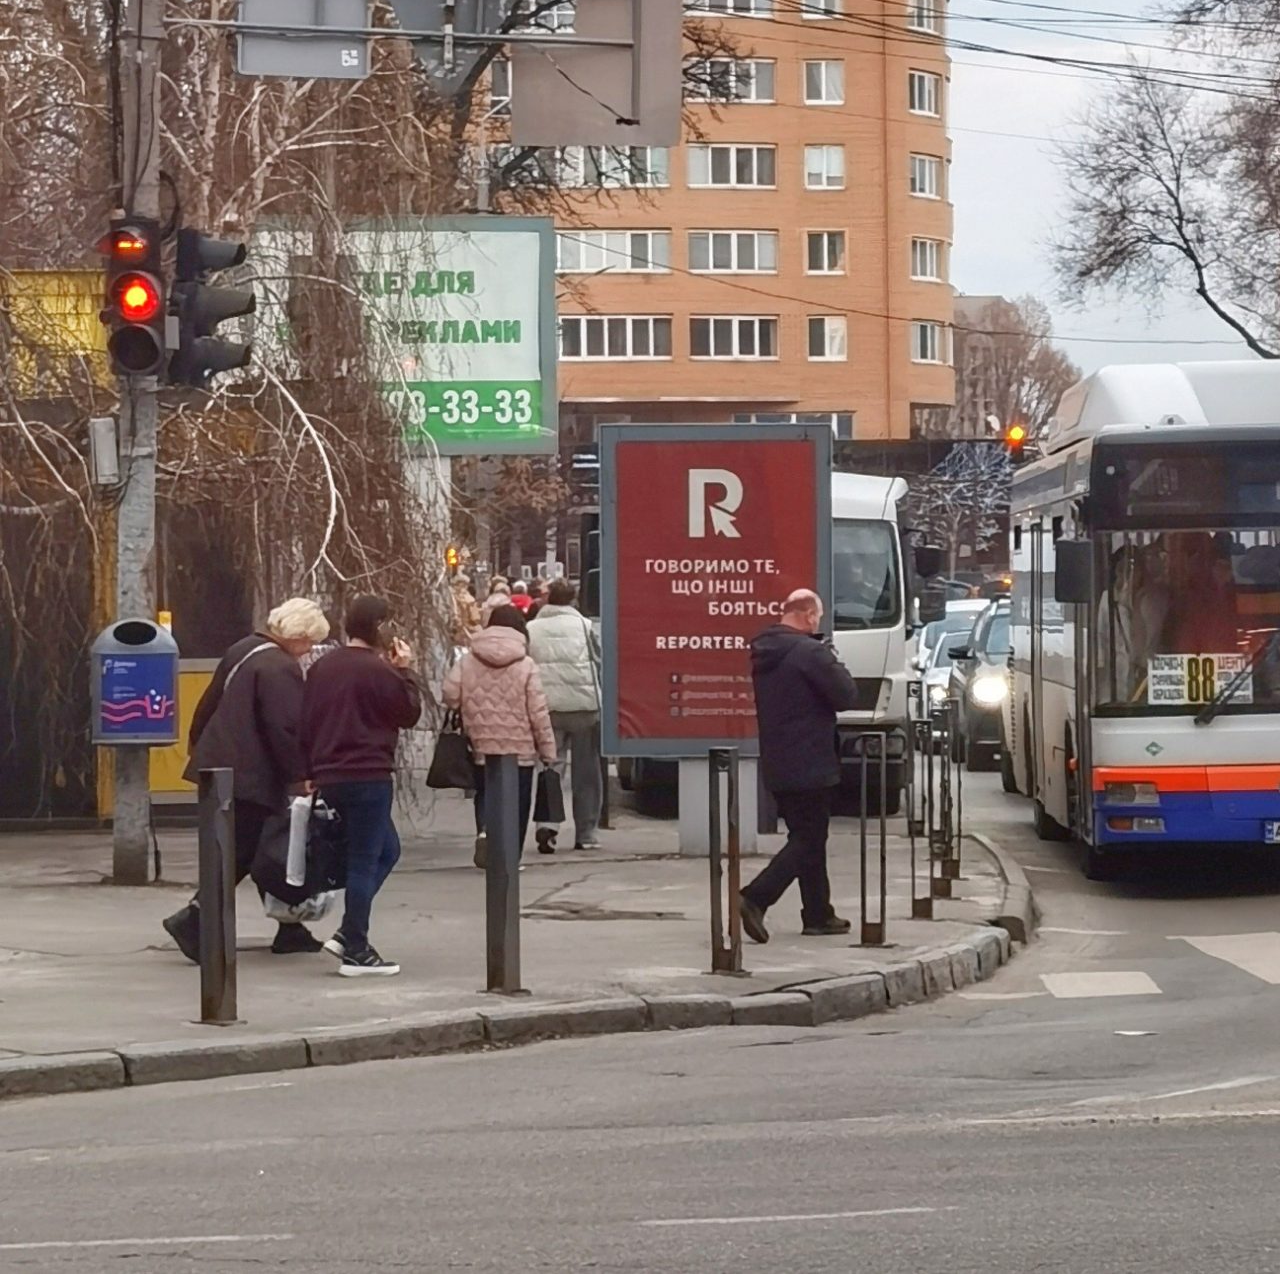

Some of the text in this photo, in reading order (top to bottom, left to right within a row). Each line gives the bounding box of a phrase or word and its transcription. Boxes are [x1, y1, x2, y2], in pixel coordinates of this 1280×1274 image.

[410, 271, 475, 297] ДЛЯ
[689, 469, 743, 537] R
[645, 559, 780, 575] ГОВОРИМО ТЕ,
[671, 580, 754, 595] ЩО ІНШІ
[656, 636, 750, 649] REPORTER.
[1187, 657, 1215, 701] 88
